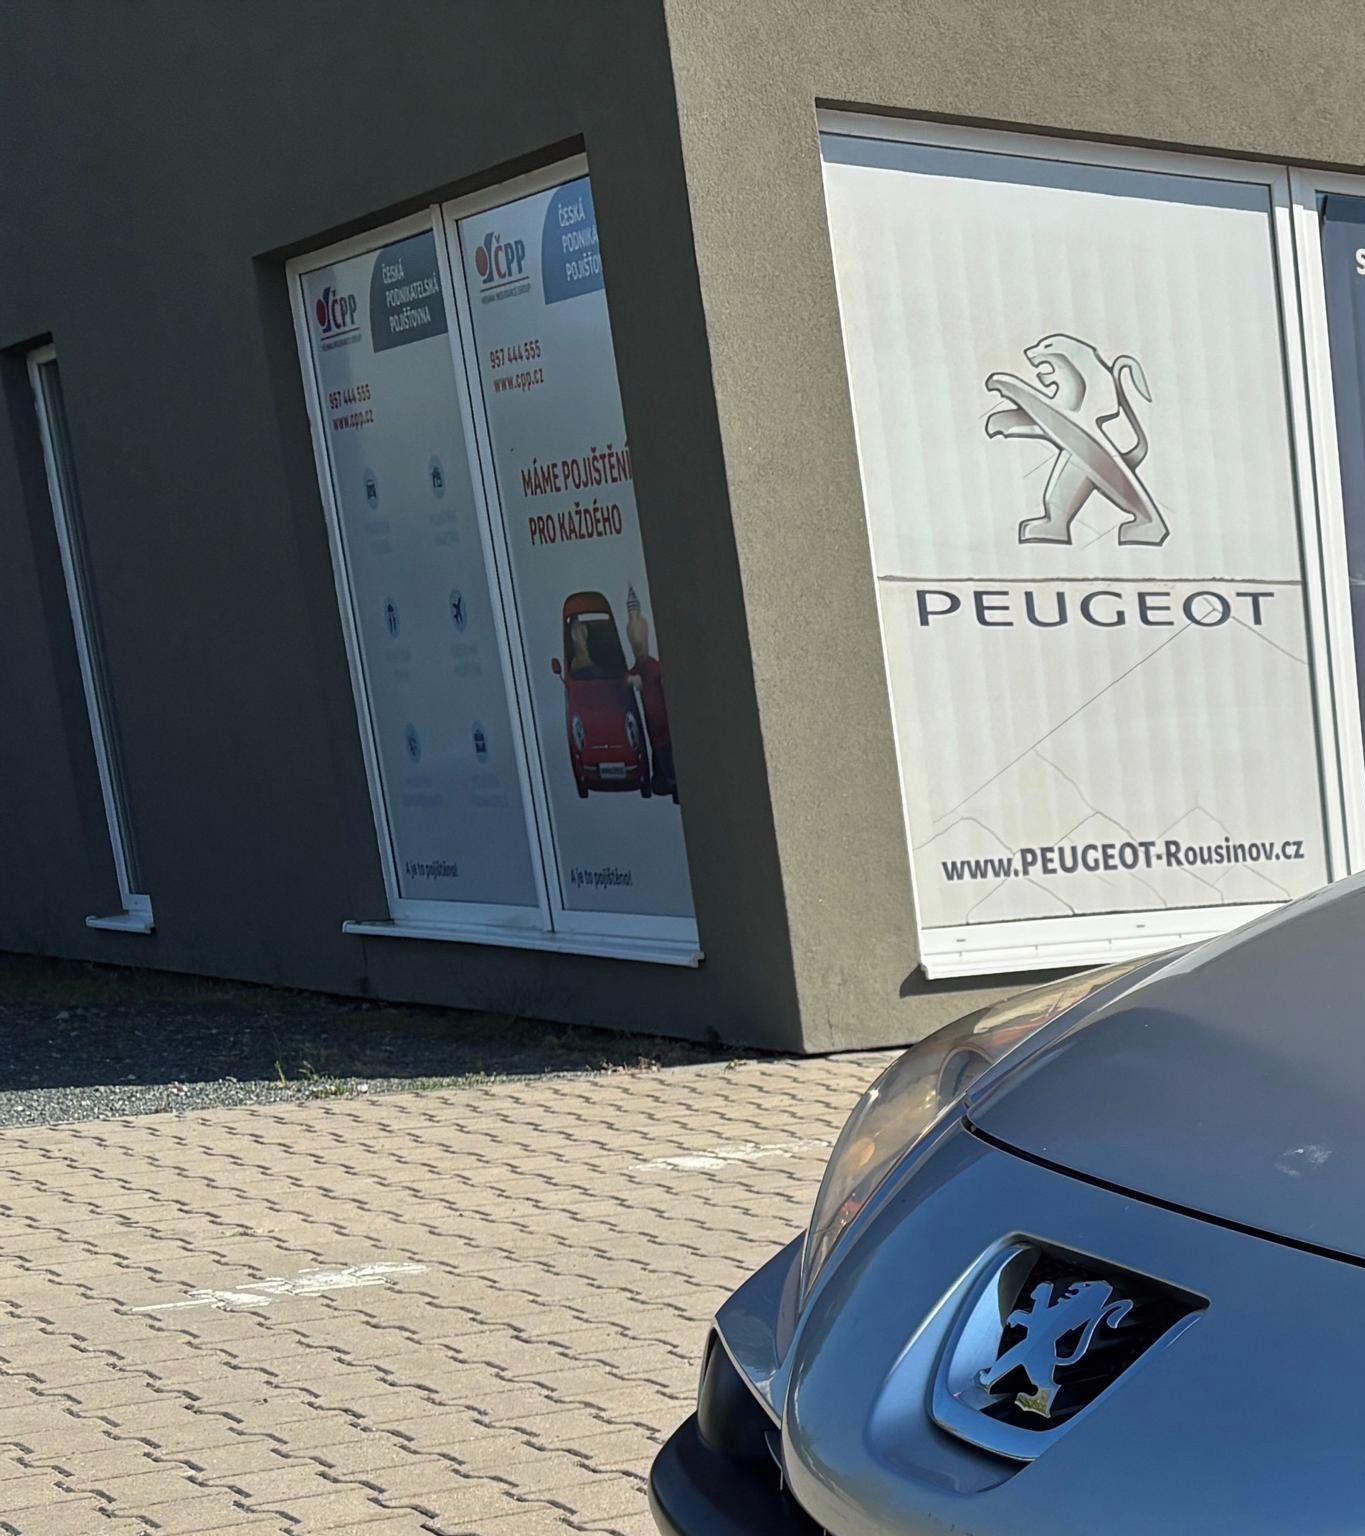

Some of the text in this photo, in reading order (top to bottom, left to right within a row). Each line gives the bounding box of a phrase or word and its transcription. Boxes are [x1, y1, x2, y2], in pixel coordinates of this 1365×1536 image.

[494, 234, 526, 280] ČPP
[507, 343, 524, 364] 444
[520, 457, 562, 497] MÁME
[528, 498, 623, 546] PRO KAŽDÉHO
[915, 589, 1275, 628] PEUGEOT
[941, 835, 1306, 883] www.PEUGEOT-Rousinov.cz
